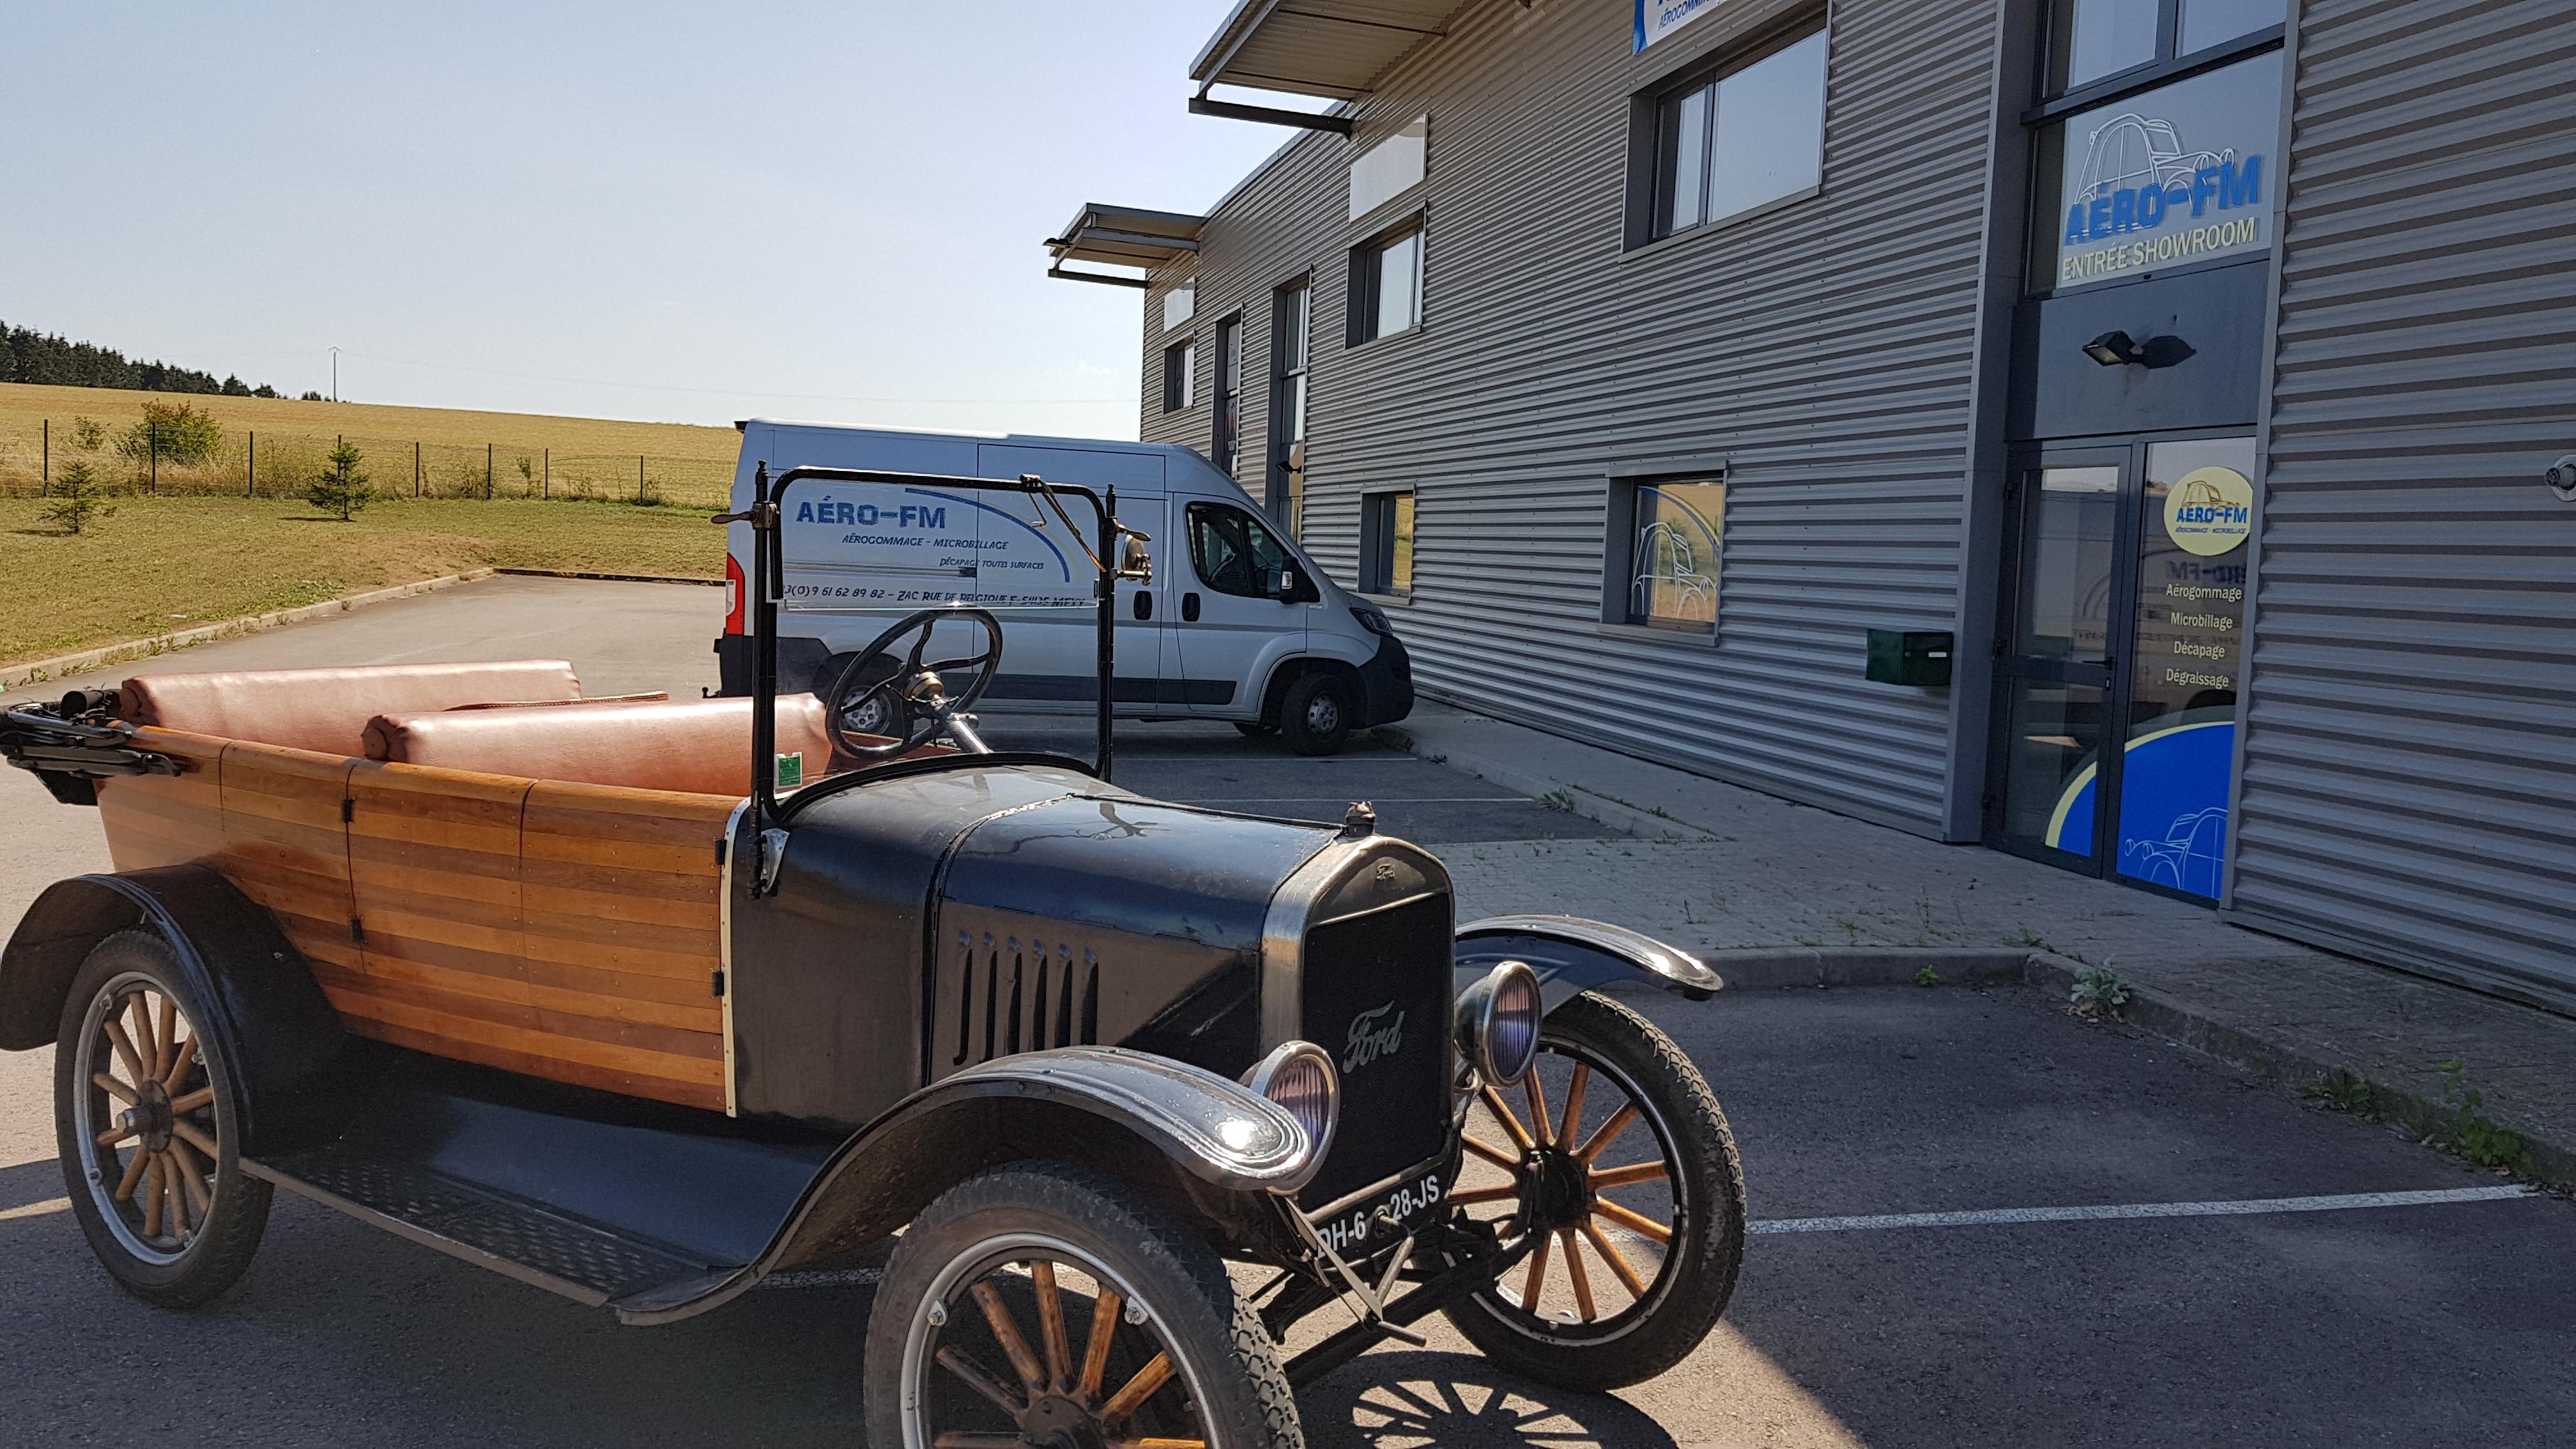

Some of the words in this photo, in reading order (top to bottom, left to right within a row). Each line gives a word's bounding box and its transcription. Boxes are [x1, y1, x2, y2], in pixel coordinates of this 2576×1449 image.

[2062, 241, 2128, 280] ENTRÉE
[2132, 217, 2255, 266] SHOWROOM
[796, 495, 946, 529] AÉRO-FM
[842, 533, 924, 546] AÉROGOMMAGE
[933, 539, 1009, 550] MICROBILLAGE
[939, 556, 981, 567] DÉCAPAGE
[982, 560, 1008, 568] TOUTES
[783, 585, 819, 597] 3(0)9
[822, 586, 832, 596] 61
[835, 587, 849, 597] 62
[852, 588, 867, 597] 89
[870, 589, 885, 599] 82
[896, 590, 919, 601] ZAC
[922, 592, 943, 601] RUE
[2166, 583, 2242, 602] Aérogommage
[2170, 611, 2234, 632] Microbillage
[2174, 640, 2226, 660] Décapage
[2166, 668, 2230, 690] Dégraissage
[1342, 1000, 1405, 1073] Ford
